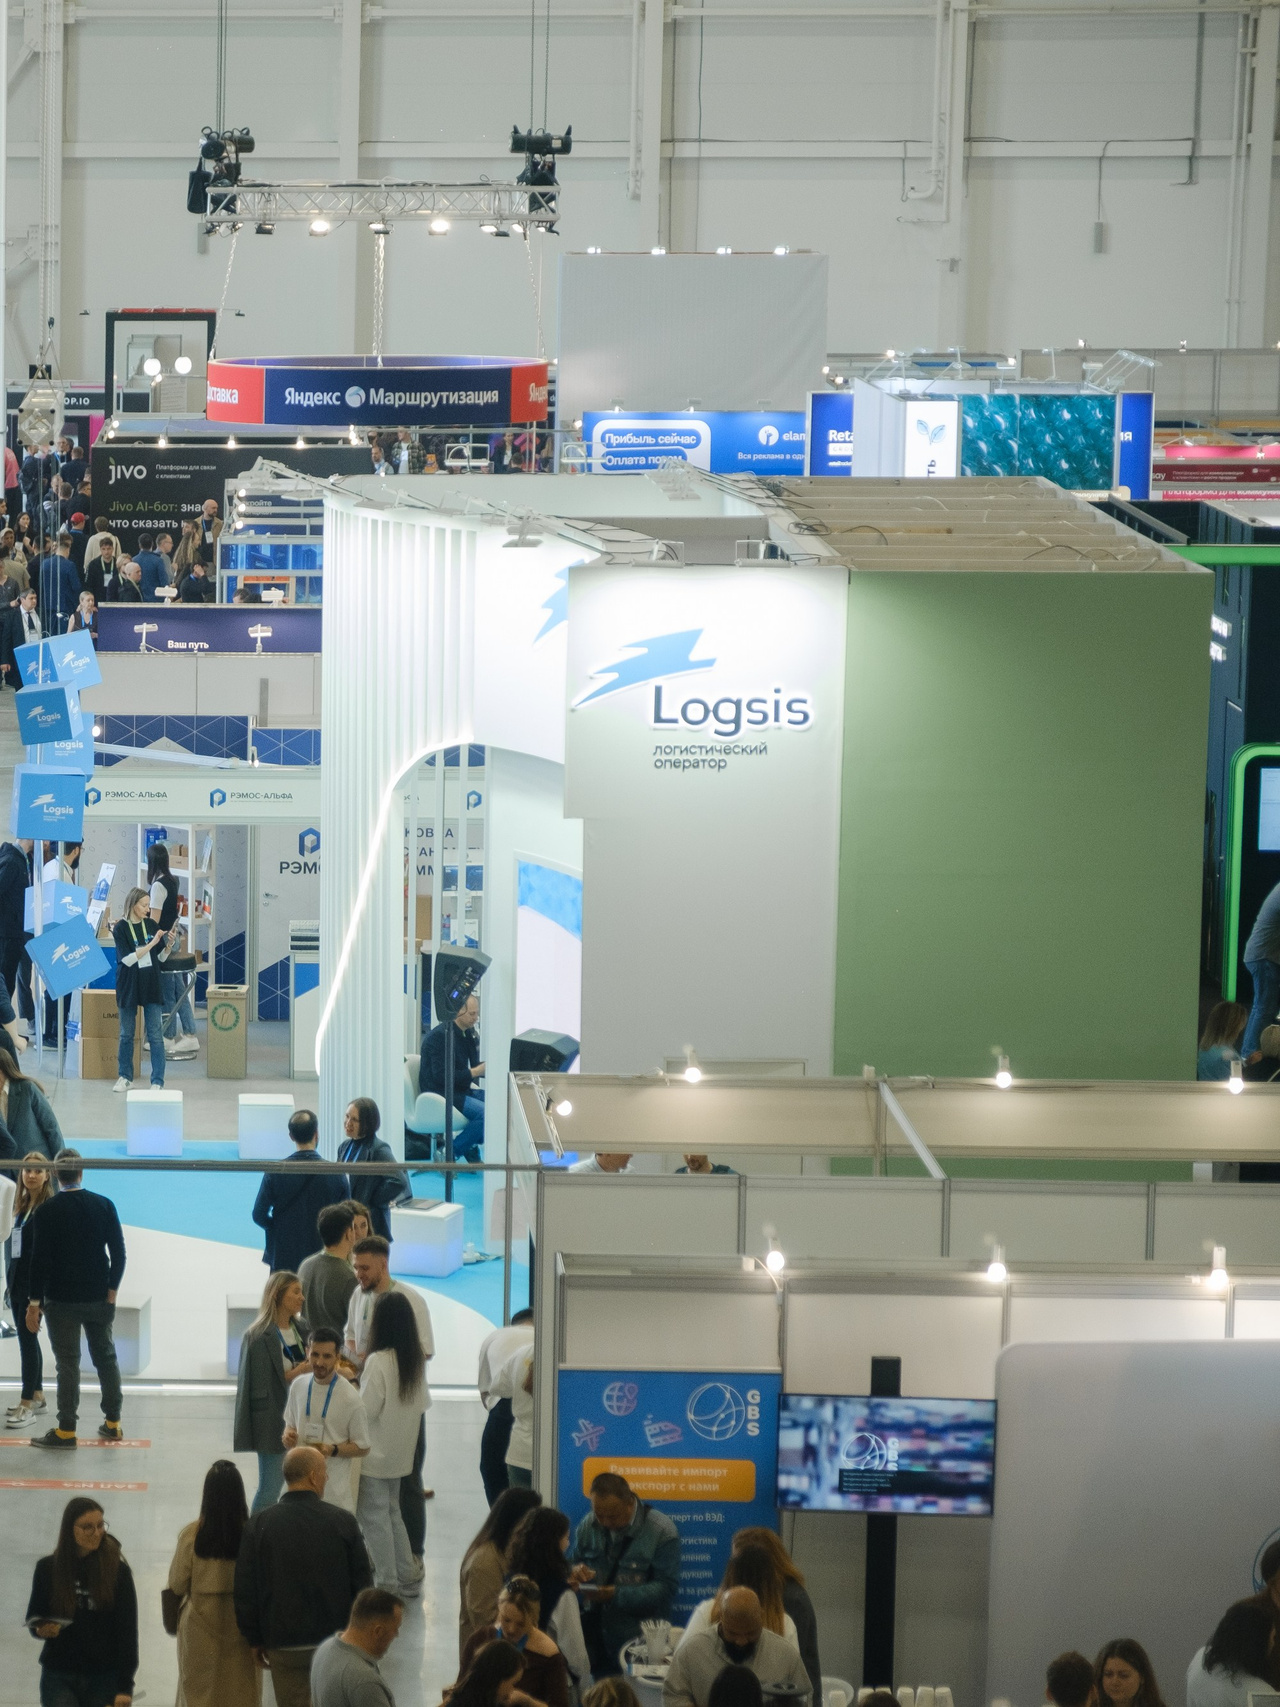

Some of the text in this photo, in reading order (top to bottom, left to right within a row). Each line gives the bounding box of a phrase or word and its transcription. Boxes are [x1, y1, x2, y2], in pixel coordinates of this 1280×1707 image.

[64, 397, 90, 405] OP.IO
[284, 388, 500, 408] Яндекс Маршрутизация
[605, 432, 697, 447] Прибыль сейчас
[828, 429, 854, 441] Reta
[606, 455, 683, 466] Оплата поом
[738, 452, 751, 460] Вся
[753, 453, 784, 462] реклама
[155, 464, 188, 472] Платформа
[109, 501, 133, 512] Jivo
[136, 501, 178, 512] AI-бот:
[109, 519, 178, 528] что сказать
[167, 641, 209, 652] Ваш путь
[70, 656, 91, 668] Logsis
[654, 685, 810, 737] Logsis
[37, 712, 62, 722] Logsis
[54, 740, 84, 750] Logsis
[653, 741, 768, 756] логистический
[654, 758, 728, 772] оператор
[43, 804, 74, 815] Logsis
[279, 861, 320, 875] РЭМ
[62, 944, 91, 962] Logsis
[747, 1390, 761, 1436] GBS
[609, 1465, 728, 1481] Развивайте импорт
[688, 1484, 720, 1492] нами
[667, 1513, 725, 1523] сперт по ВЭД:
[680, 1537, 718, 1546] огистика
